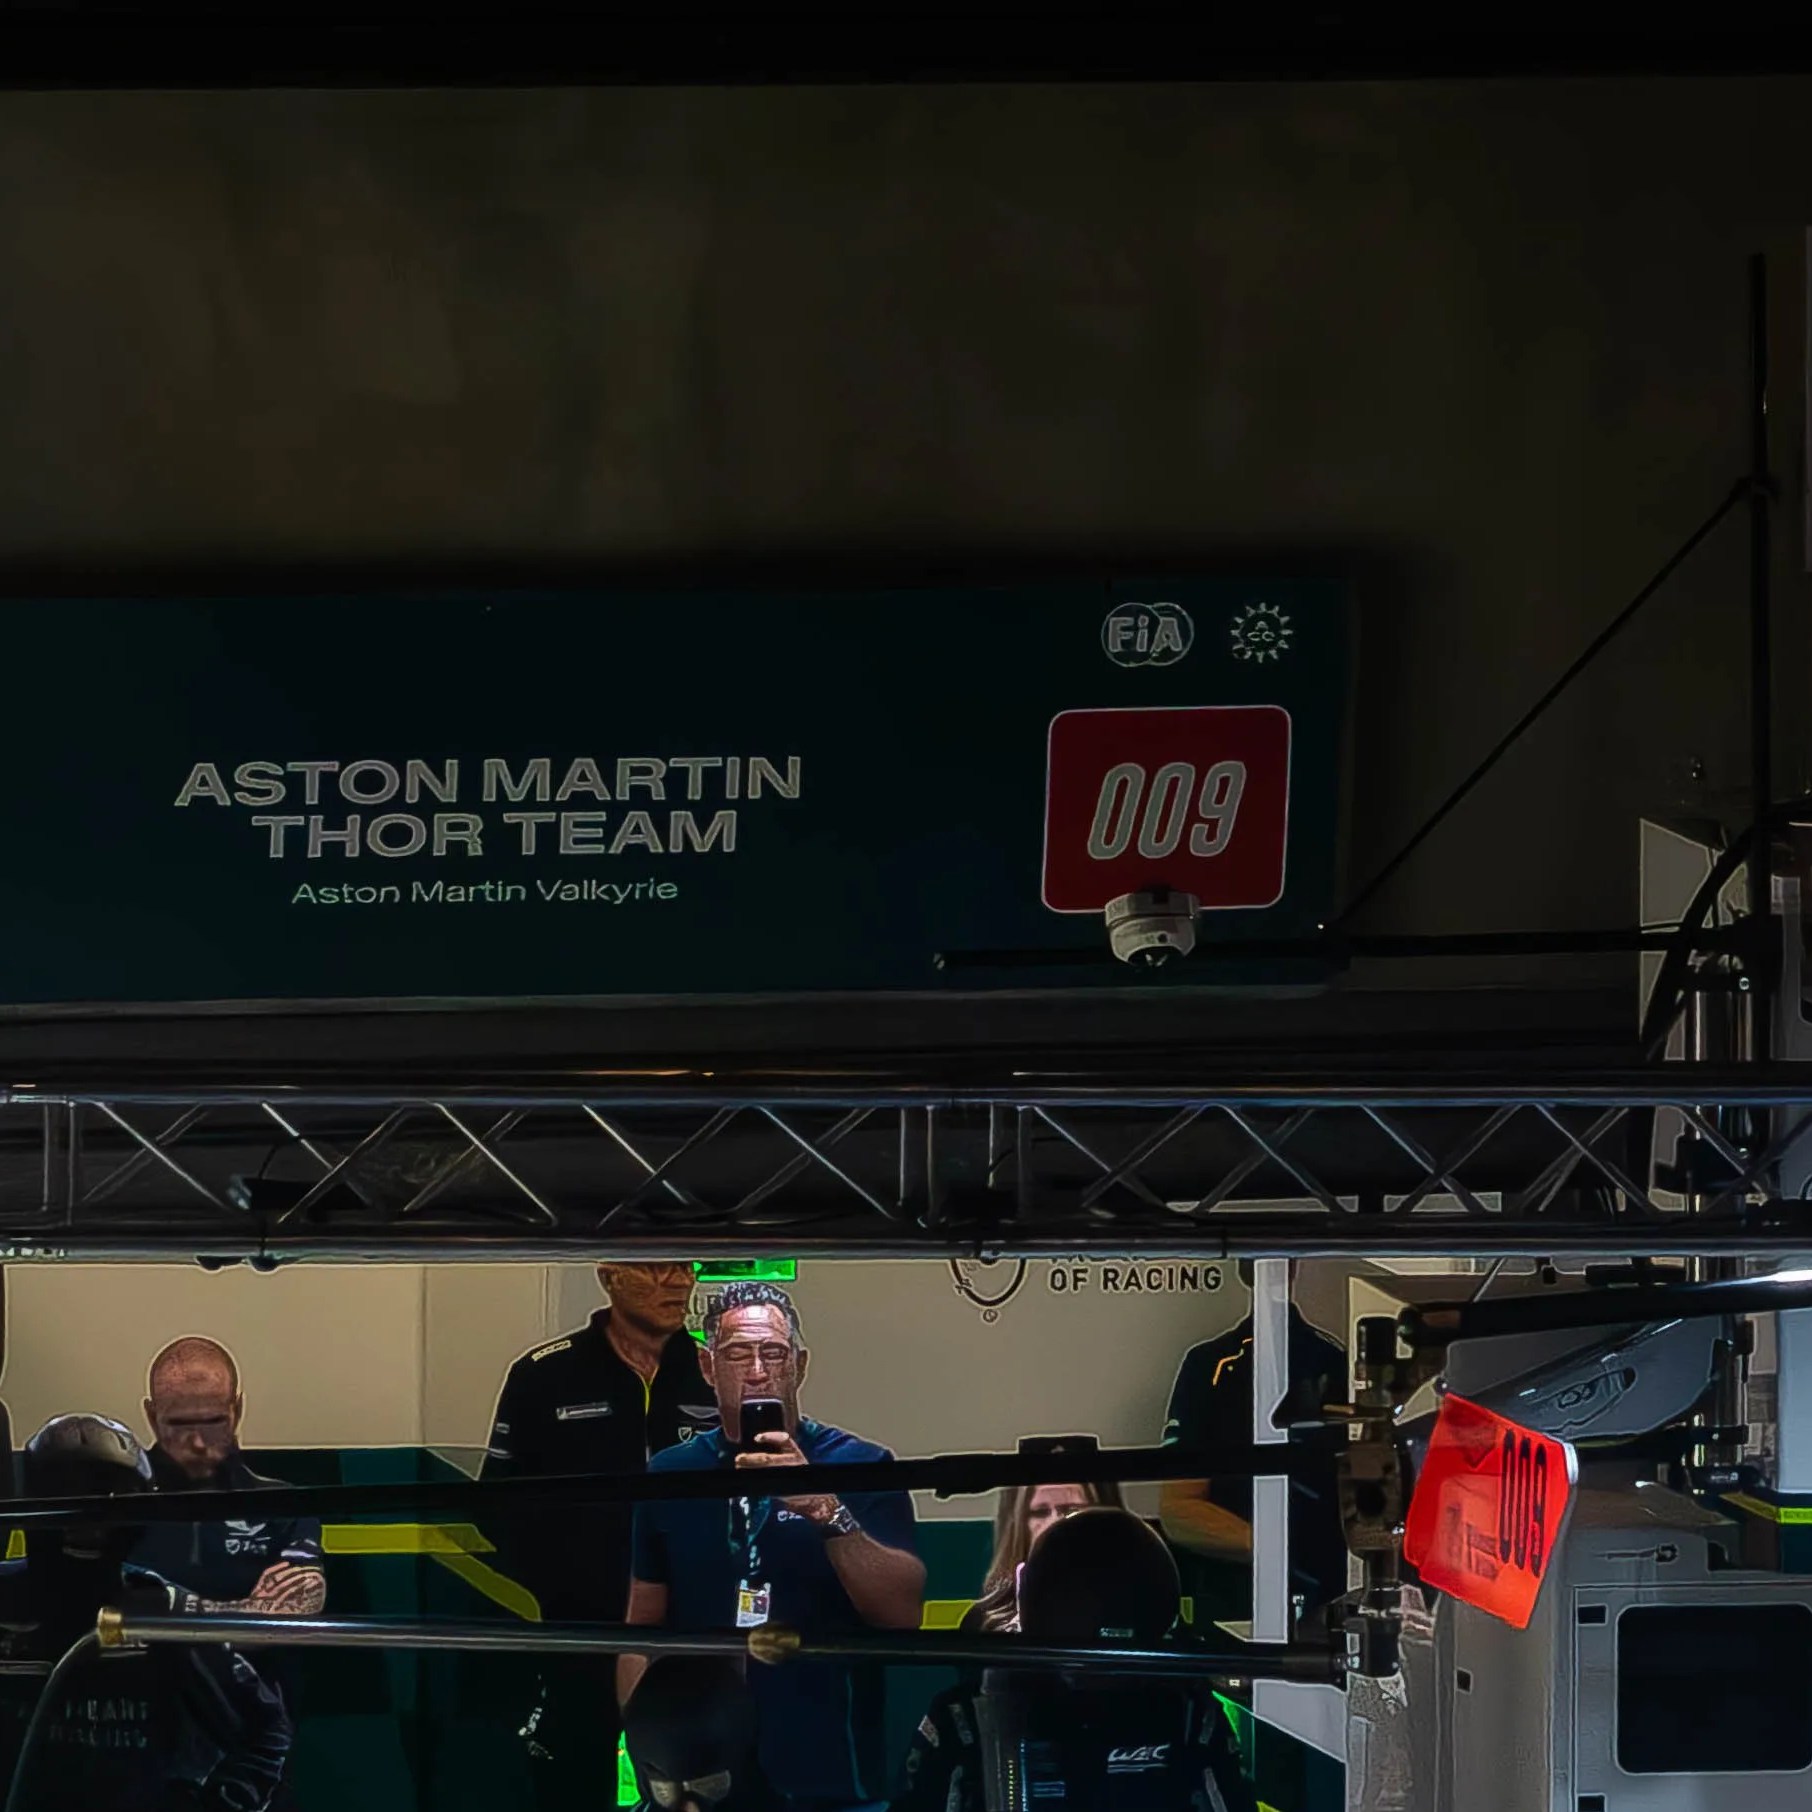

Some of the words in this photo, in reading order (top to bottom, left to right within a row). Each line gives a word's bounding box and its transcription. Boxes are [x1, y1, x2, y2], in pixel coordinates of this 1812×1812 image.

[174, 758, 460, 806] ASTON
[482, 755, 802, 802] MARTIN
[251, 812, 484, 858] THOR
[502, 810, 738, 856] TEAM
[1087, 760, 1247, 860] 009
[291, 881, 401, 905] Aston
[411, 878, 527, 902] Martin
[535, 875, 679, 904] Valkyrie
[1050, 1268, 1089, 1291] OF
[1102, 1266, 1222, 1291] RACING
